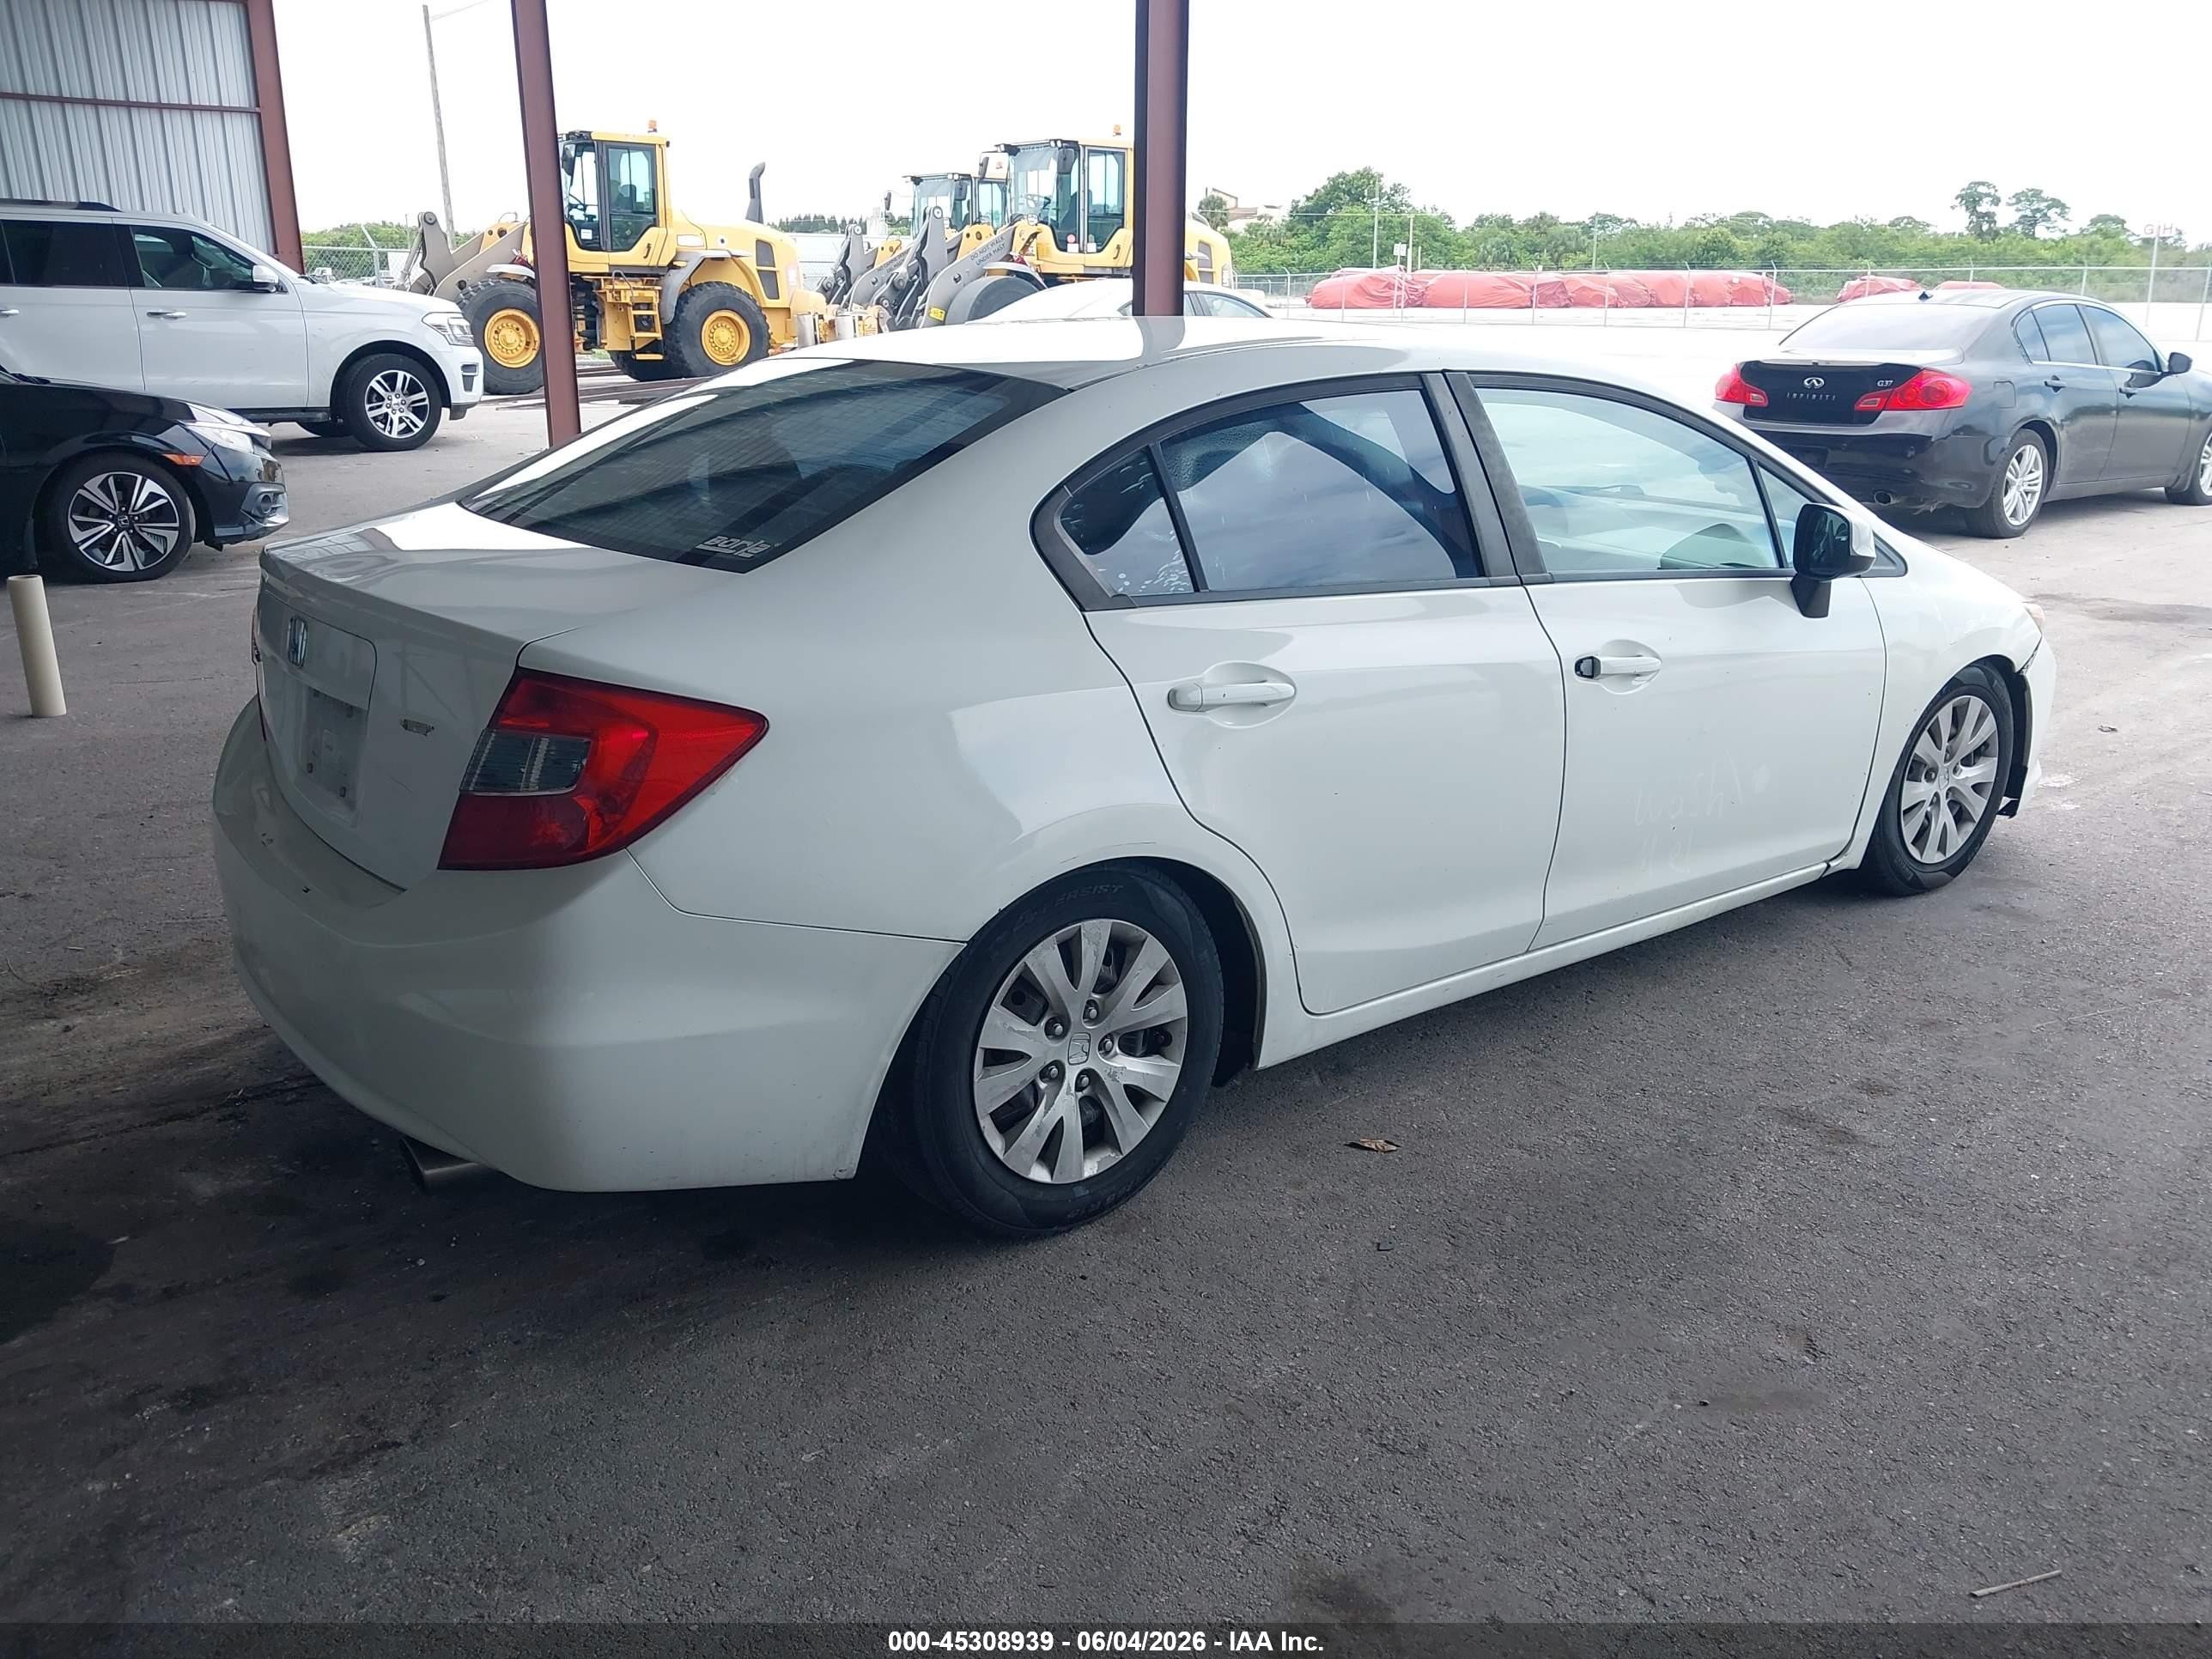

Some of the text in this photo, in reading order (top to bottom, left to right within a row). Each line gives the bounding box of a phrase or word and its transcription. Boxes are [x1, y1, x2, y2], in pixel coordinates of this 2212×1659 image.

[989, 235, 1005, 247] WALK
[975, 243, 1006, 265] UNDER MAST
